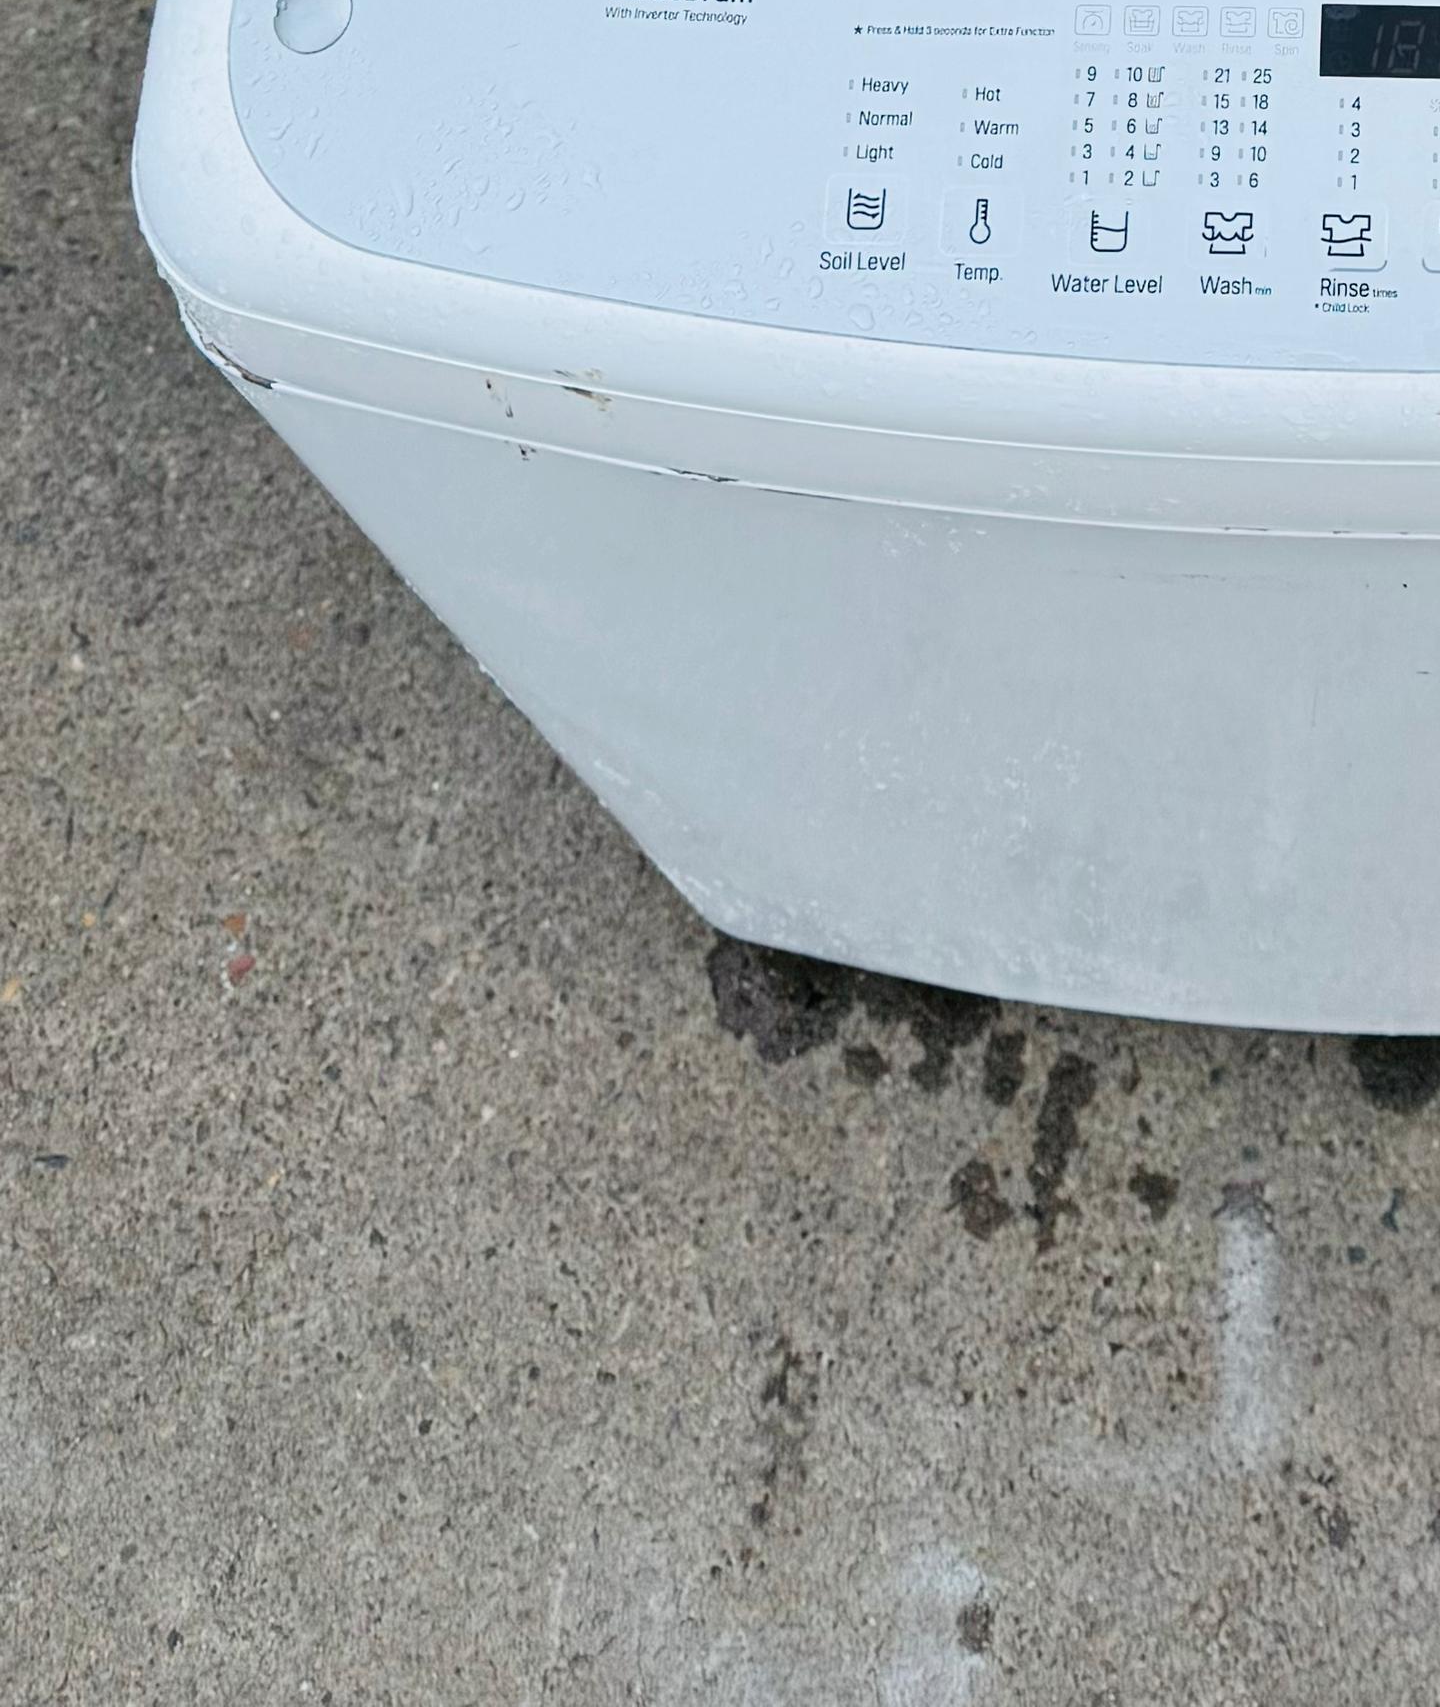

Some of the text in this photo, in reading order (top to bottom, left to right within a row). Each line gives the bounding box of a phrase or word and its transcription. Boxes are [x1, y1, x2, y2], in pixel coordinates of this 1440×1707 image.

[606, 7, 632, 18] With
[684, 10, 747, 25] Technology
[1088, 66, 1096, 81] 9
[1128, 67, 1142, 82] 10
[1215, 68, 1230, 83] 21
[1254, 69, 1271, 84] 25
[862, 78, 908, 95] Heavy
[976, 87, 1000, 101] Hot
[1087, 92, 1095, 107] 7
[1128, 93, 1137, 107] 8
[1214, 94, 1229, 109] 15
[1253, 94, 1268, 109] 18
[1352, 97, 1360, 110] 4
[859, 111, 912, 126] Normal
[1085, 118, 1093, 133] 5
[1127, 119, 1136, 133] 6
[975, 120, 1018, 135] Warm
[1213, 120, 1228, 135] 13
[1252, 121, 1267, 135] 14
[1352, 122, 1360, 137] 3
[857, 145, 893, 162] Light
[1083, 144, 1092, 159] 3
[1126, 145, 1134, 159] 4
[1212, 146, 1220, 161] 9
[1251, 146, 1266, 162] 10
[1351, 148, 1359, 163] 2
[971, 154, 1003, 169] Cold
[1083, 170, 1088, 185] 1
[1124, 171, 1133, 186] 2
[1210, 172, 1219, 187] 3
[1249, 173, 1258, 188] 6
[1352, 175, 1356, 190] 1
[820, 251, 905, 270] Soil Level
[955, 263, 1002, 284] Temp.
[1052, 274, 1162, 293] Water Level
[1201, 276, 1271, 295] Wash min
[1321, 278, 1369, 297] Rinse
